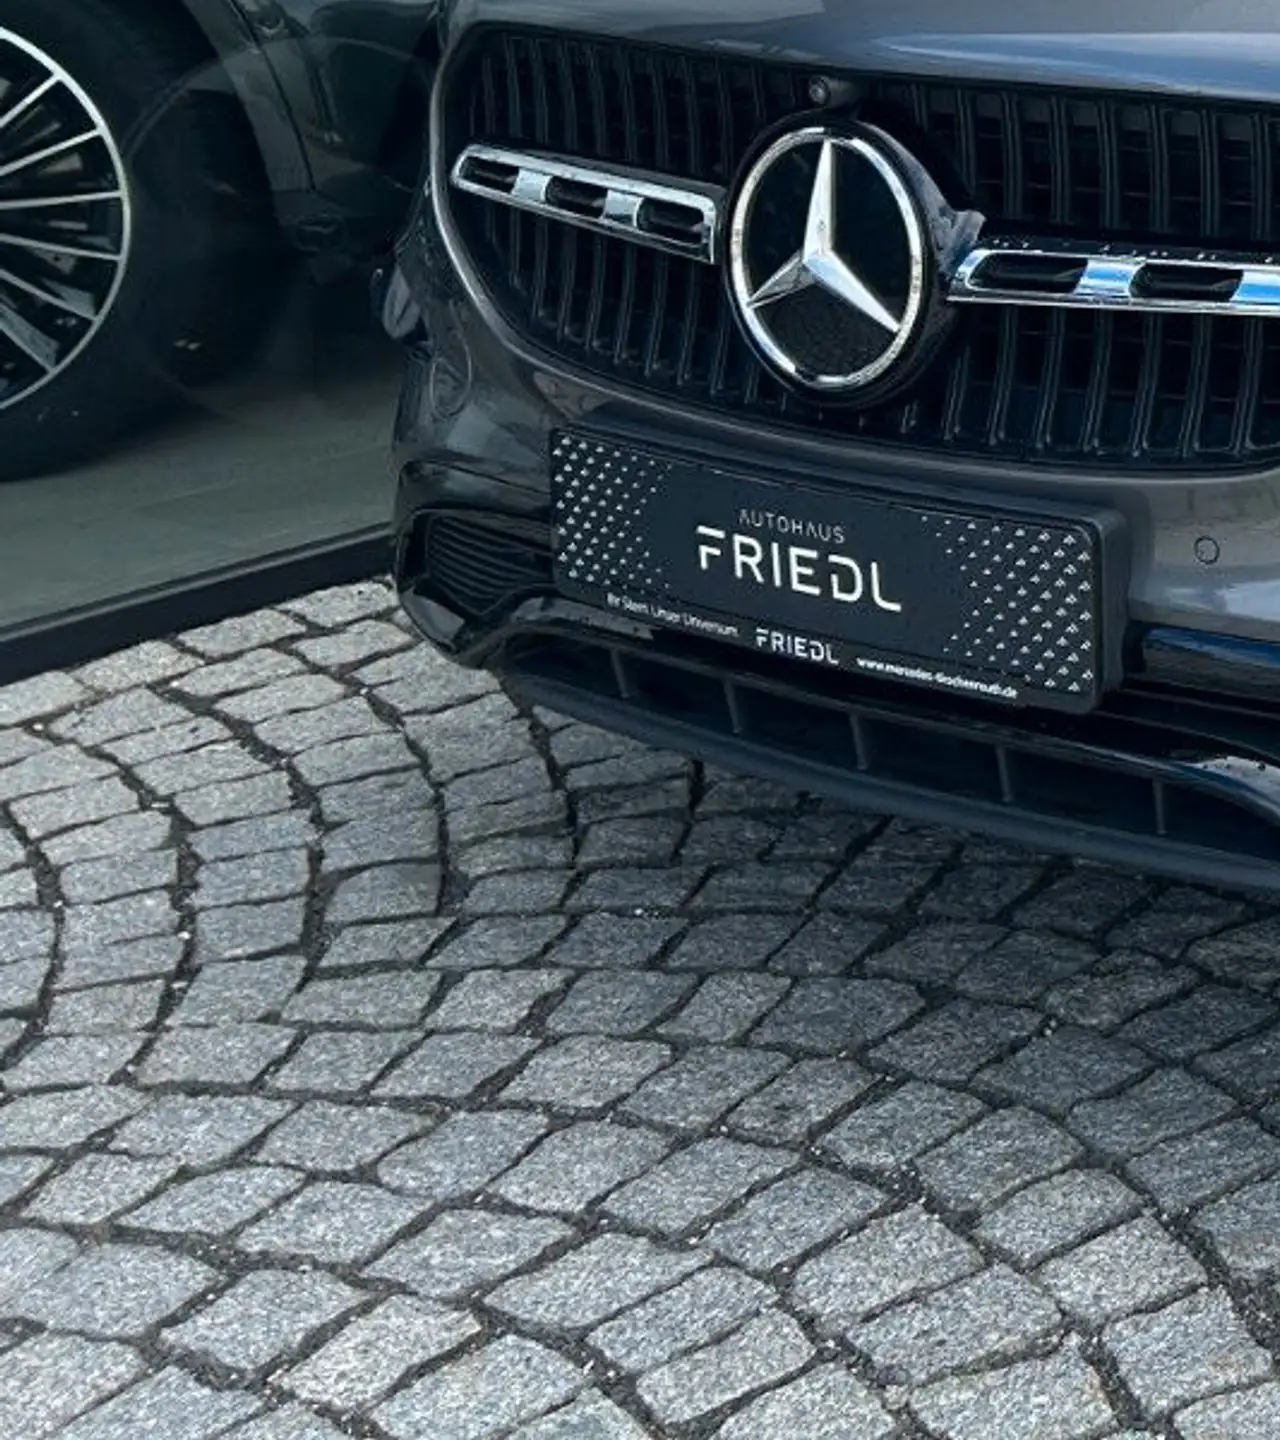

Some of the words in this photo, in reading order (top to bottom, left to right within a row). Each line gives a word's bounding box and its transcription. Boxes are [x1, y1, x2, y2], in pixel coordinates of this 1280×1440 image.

[738, 508, 846, 545] AUTOHAUS
[695, 524, 902, 613] FRIEDL
[755, 626, 840, 666] FRIEDL
